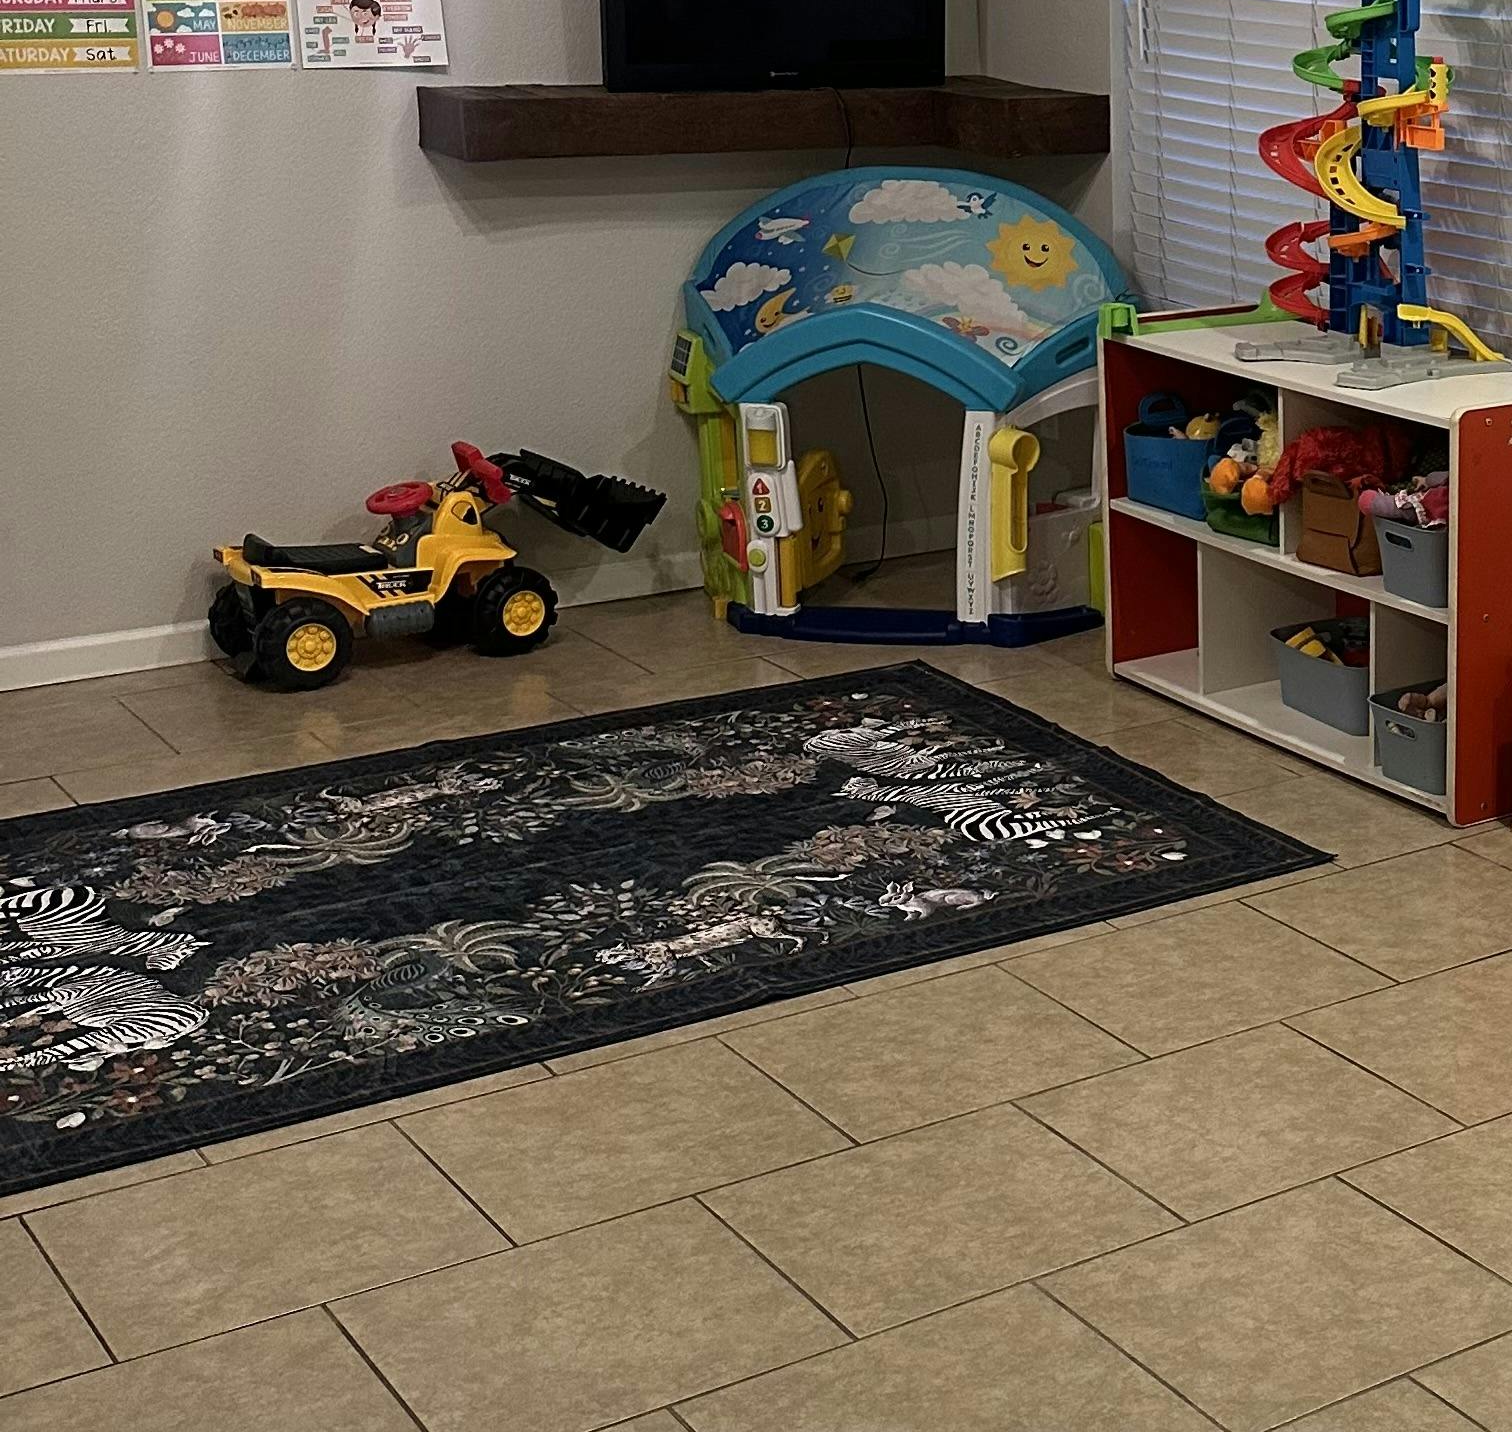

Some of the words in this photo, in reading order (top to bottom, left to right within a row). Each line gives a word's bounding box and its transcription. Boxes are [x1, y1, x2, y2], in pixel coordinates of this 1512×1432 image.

[193, 20, 216, 30] MAY
[227, 18, 288, 30] NOVEMBER
[189, 51, 221, 63] JUNE
[232, 49, 290, 61] DECEMBER
[756, 483, 763, 494] 1
[758, 500, 767, 511] 2
[760, 519, 769, 529] 3
